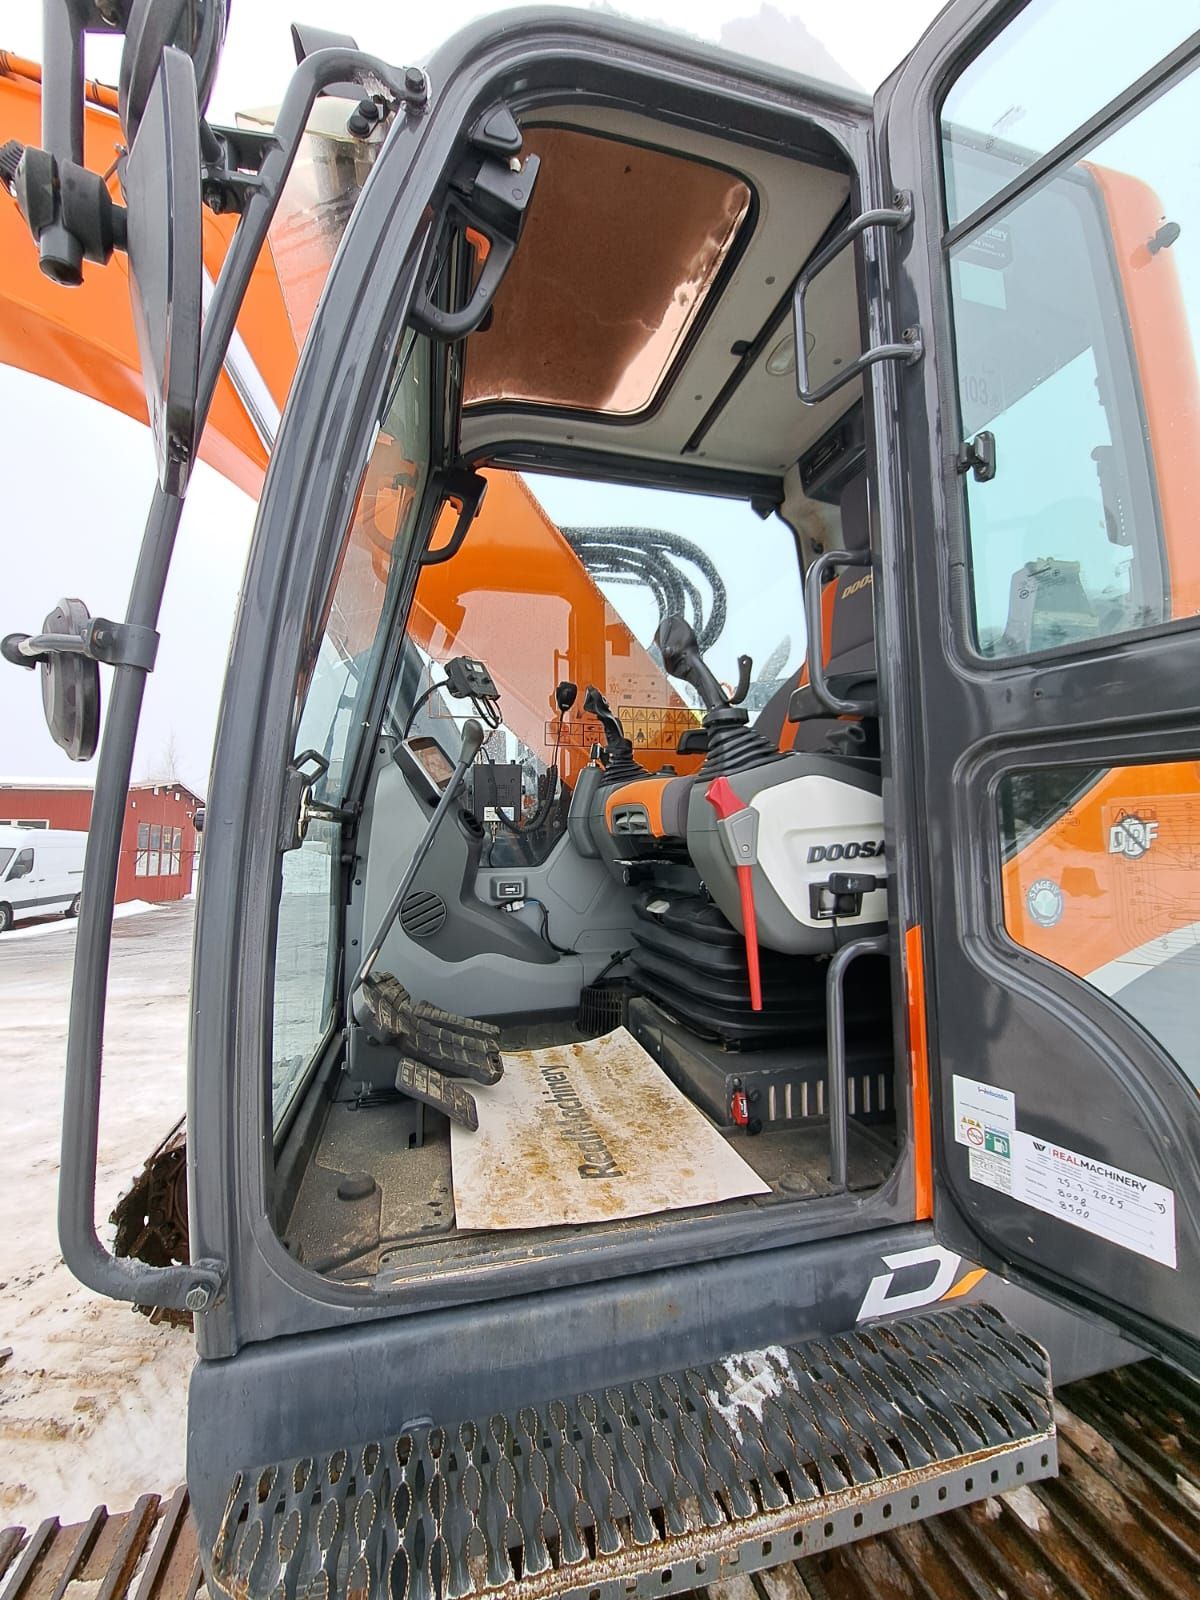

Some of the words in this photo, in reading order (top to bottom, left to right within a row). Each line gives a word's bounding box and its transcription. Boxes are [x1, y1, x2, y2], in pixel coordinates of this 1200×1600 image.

[1109, 822, 1159, 854] DPF
[1029, 880, 1051, 899] STAGE
[1052, 1149, 1147, 1192] REALMACHINERY
